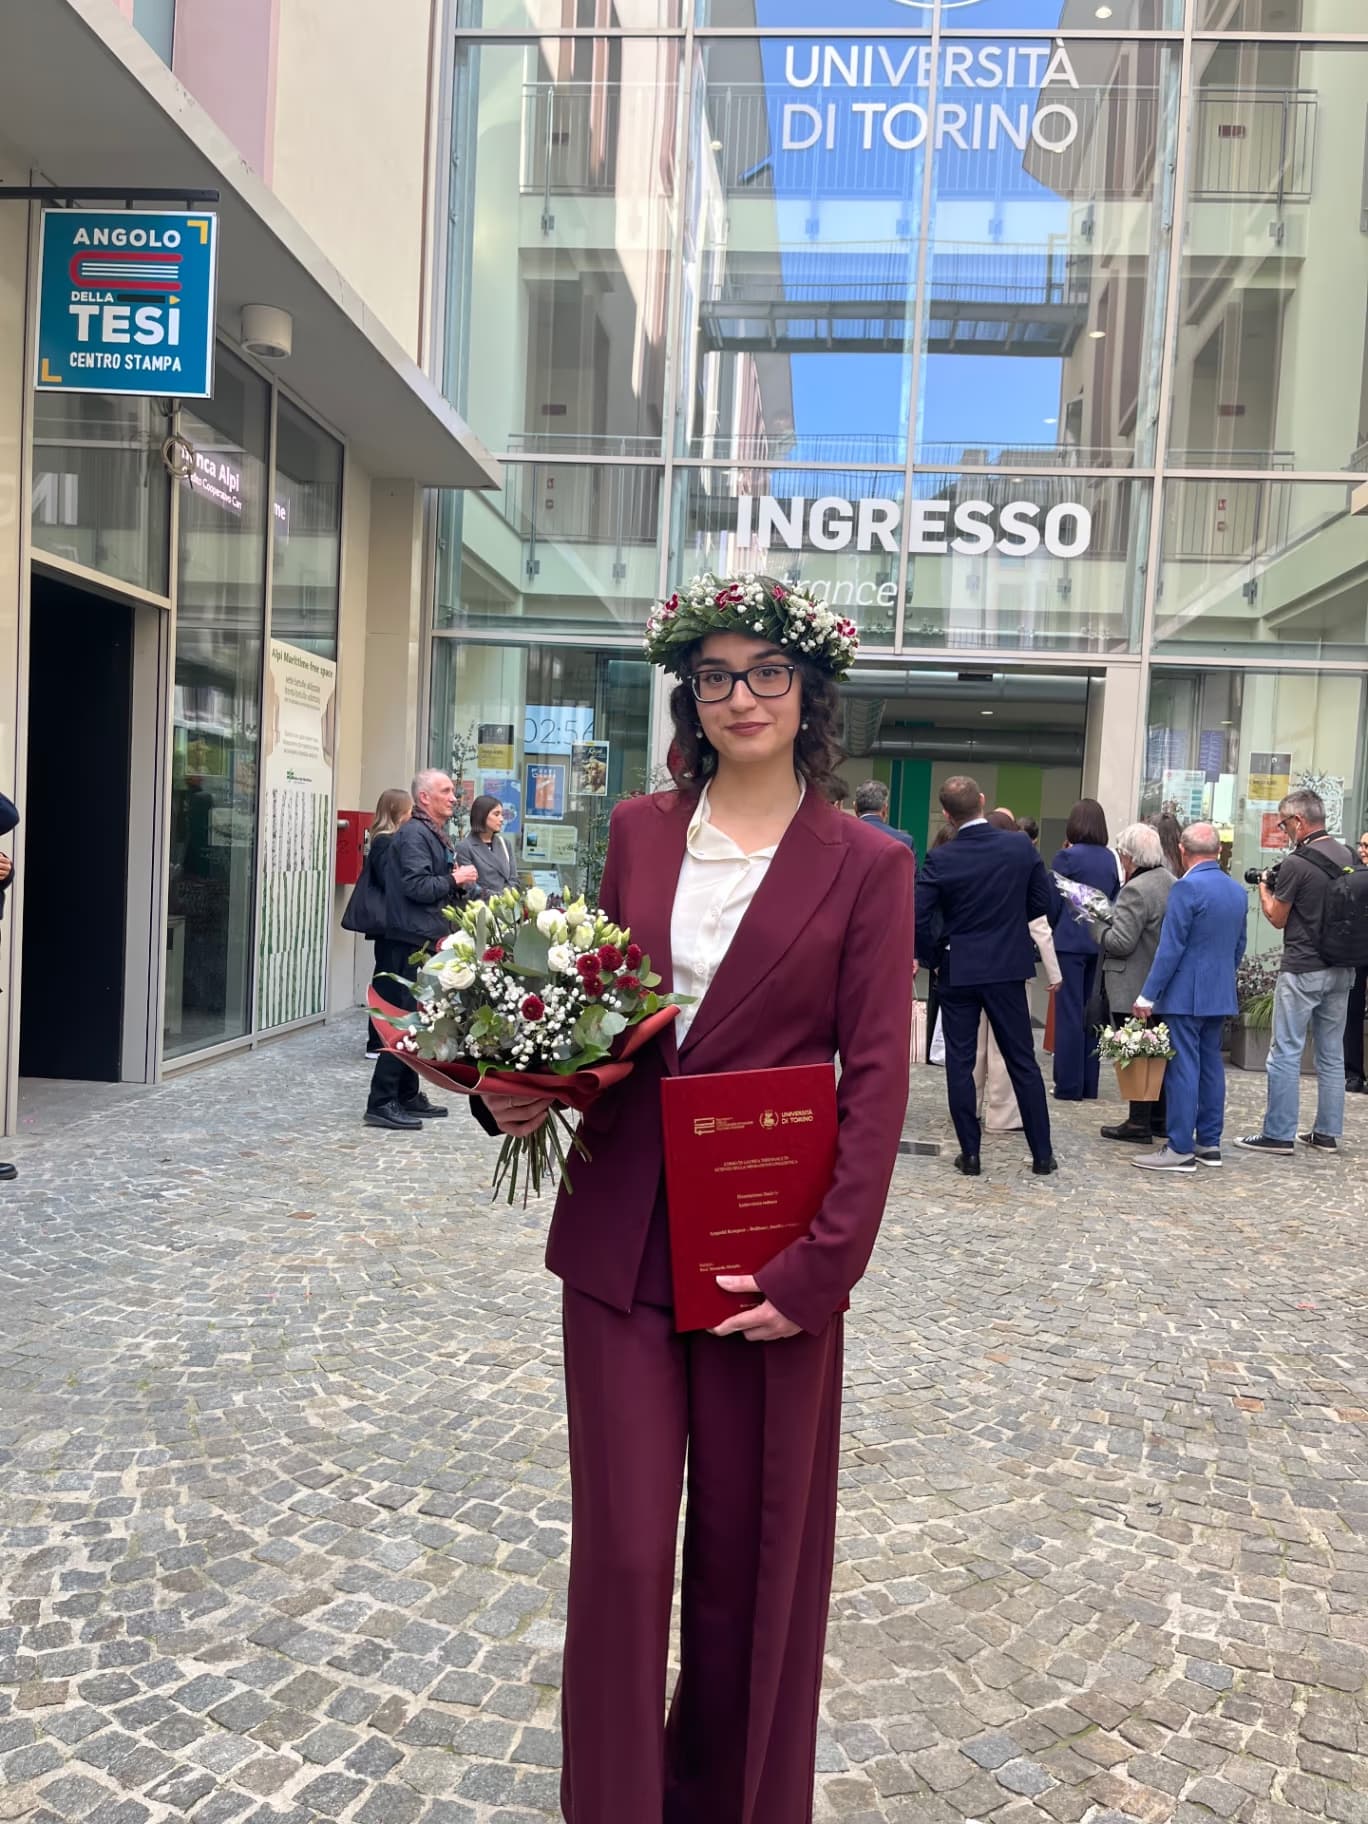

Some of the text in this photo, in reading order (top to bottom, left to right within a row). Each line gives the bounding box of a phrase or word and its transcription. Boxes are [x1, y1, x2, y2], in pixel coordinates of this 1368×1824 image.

[784, 38, 1080, 89] UNIVERSITÀ
[781, 103, 1079, 153] DI TORINO
[73, 226, 182, 249] ANGOLO
[71, 290, 115, 303] DELLA
[69, 304, 181, 346] TESI
[69, 351, 183, 372] CENTRO STAMPA
[218, 463, 241, 493] Alpi
[737, 495, 1092, 558] INGRESSO
[782, 572, 897, 607] trance
[271, 647, 283, 663] Alpi
[790, 1115, 814, 1124] TORINO
